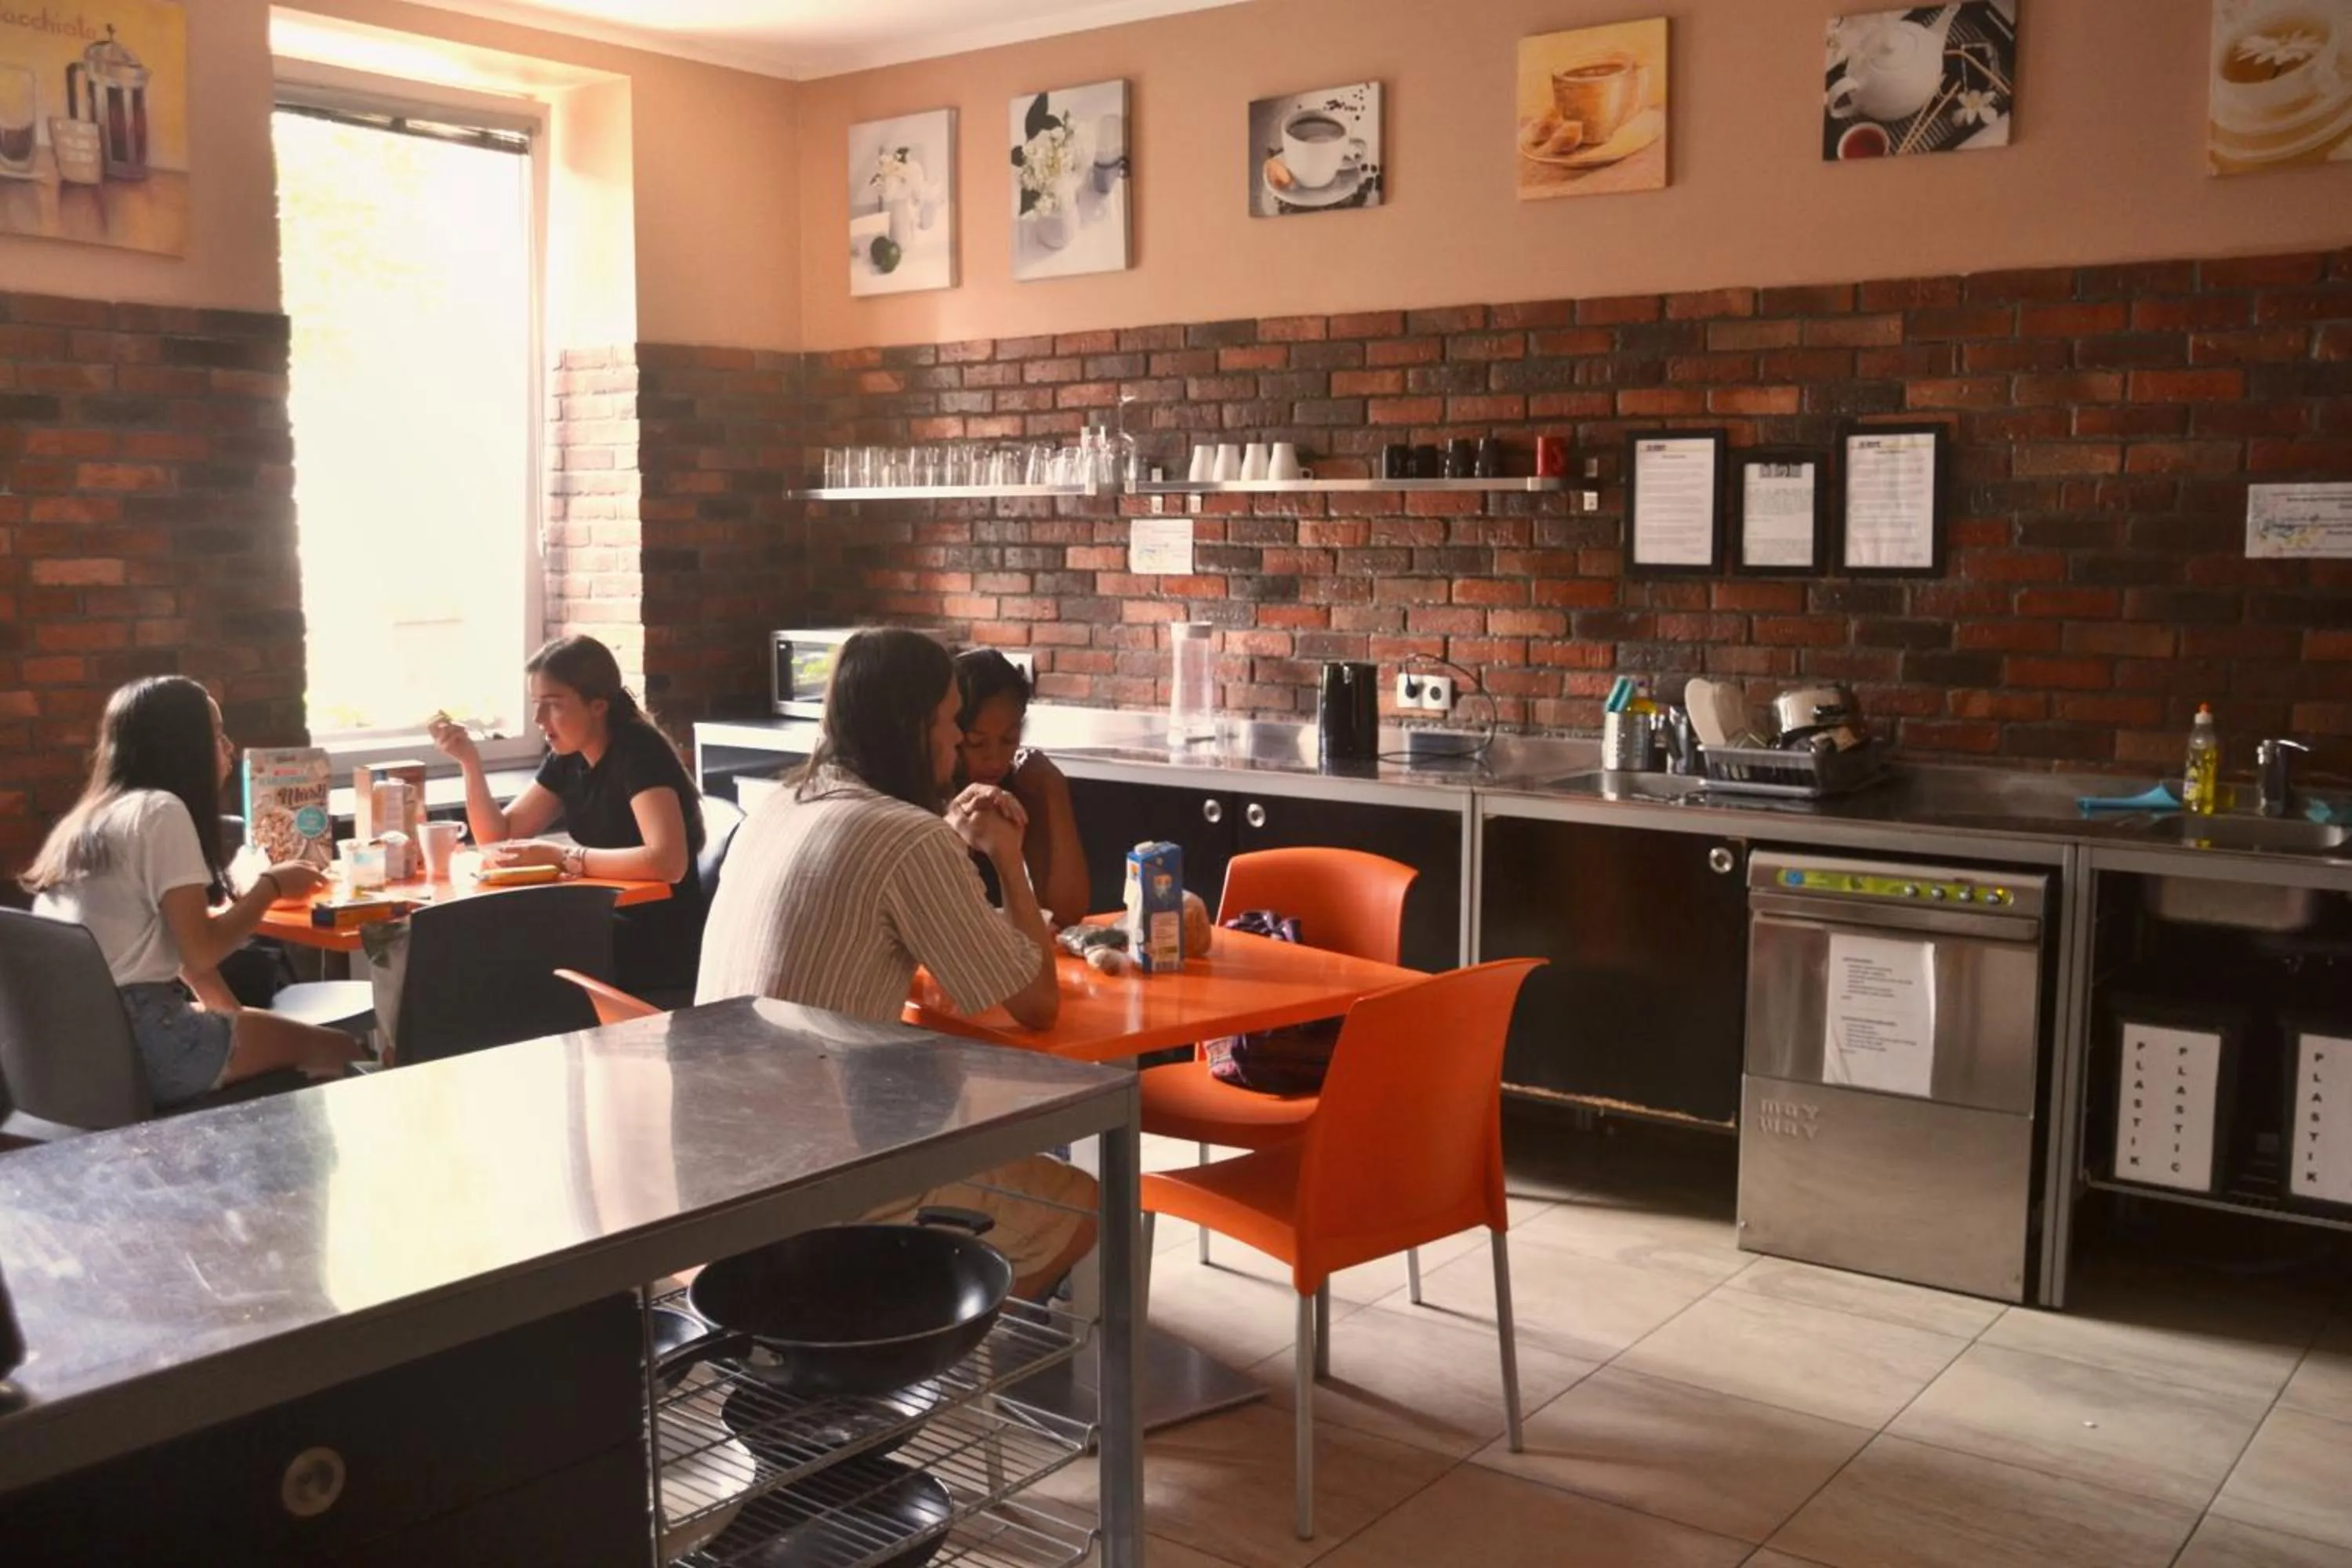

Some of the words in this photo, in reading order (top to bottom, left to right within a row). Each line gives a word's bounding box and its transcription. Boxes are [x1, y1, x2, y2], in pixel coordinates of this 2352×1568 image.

[0, 4, 97, 40] acchiato
[2129, 1040, 2146, 1167] PLASTIK
[2170, 1046, 2188, 1173] PLASTIC
[2306, 1051, 2325, 1183] PLASTIK
